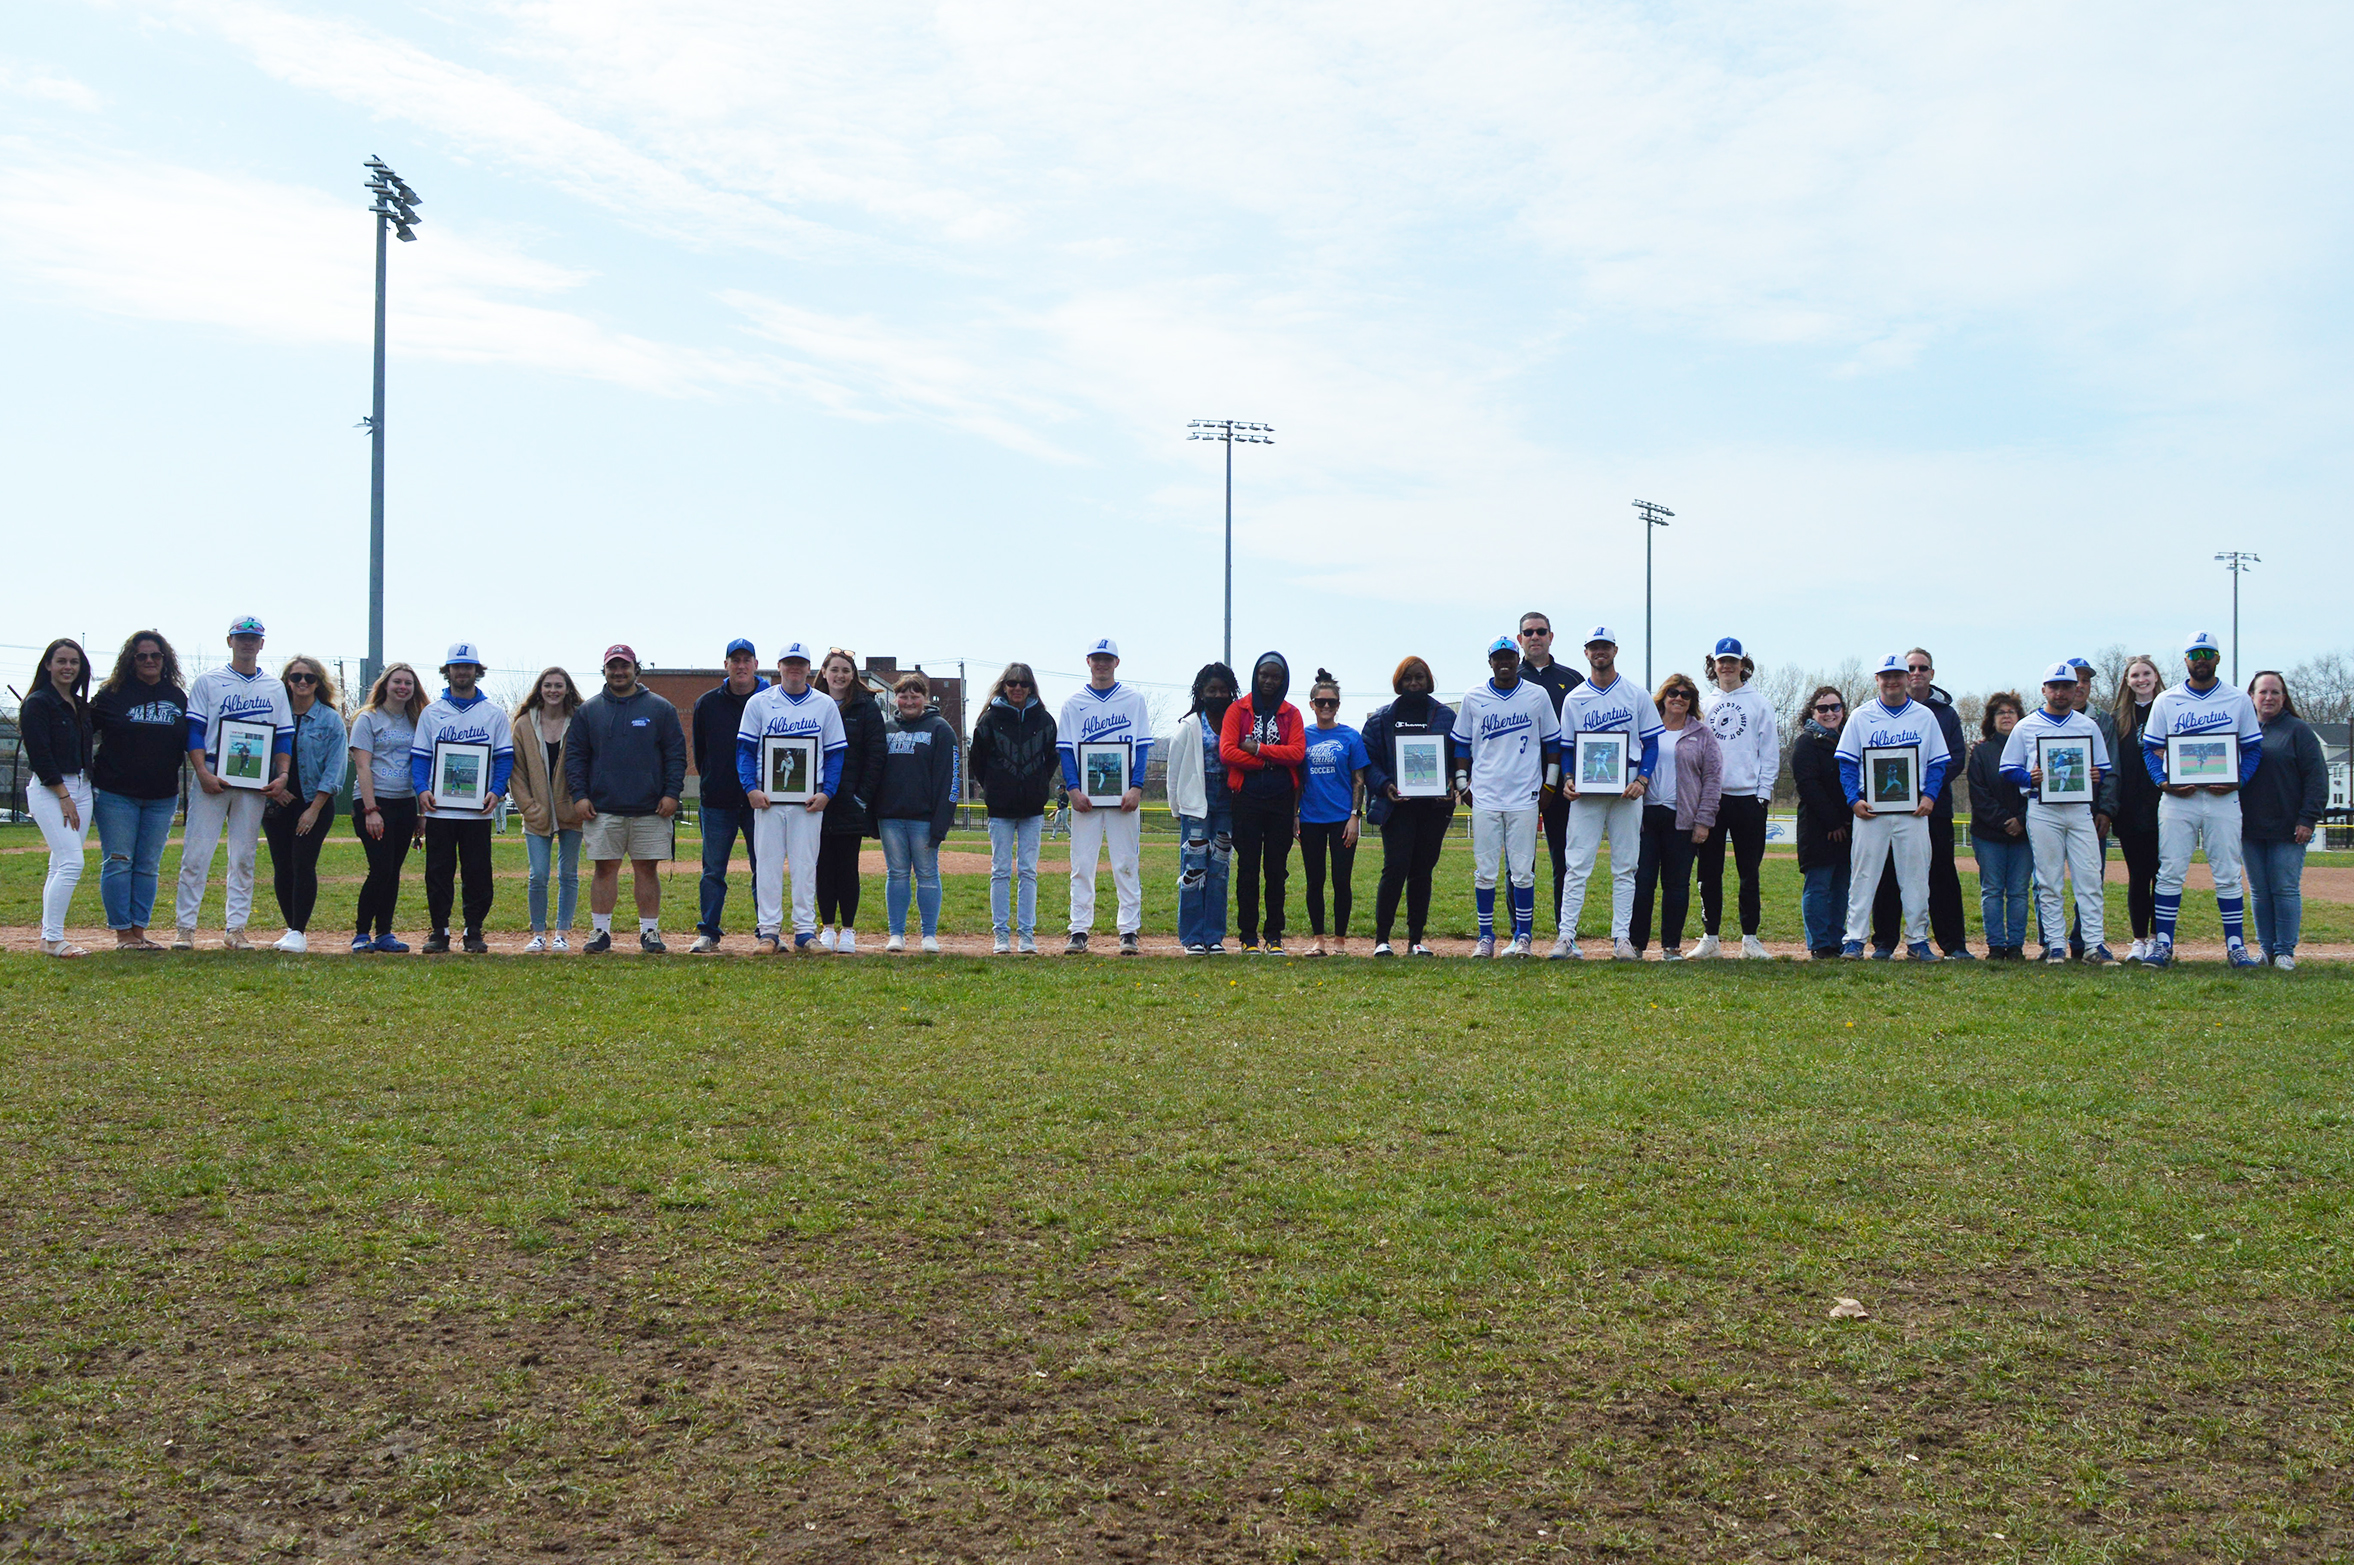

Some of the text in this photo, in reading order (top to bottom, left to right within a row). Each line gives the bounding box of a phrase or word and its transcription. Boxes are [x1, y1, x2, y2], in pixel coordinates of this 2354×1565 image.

[129, 707, 168, 716] ALBERUS
[219, 694, 273, 715] Albertus
[765, 716, 821, 736] Albertus
[1081, 713, 1131, 738] Albertus
[1395, 721, 1428, 729] Champ
[1480, 712, 1532, 735] Albertus
[1583, 707, 1632, 731] Albertus
[2174, 710, 2233, 733] Albertus
[435, 725, 489, 742] Albertus
[1868, 730, 1922, 747] Albertus
[381, 768, 408, 778] BASEB
[1310, 766, 1336, 775] SOCCER
